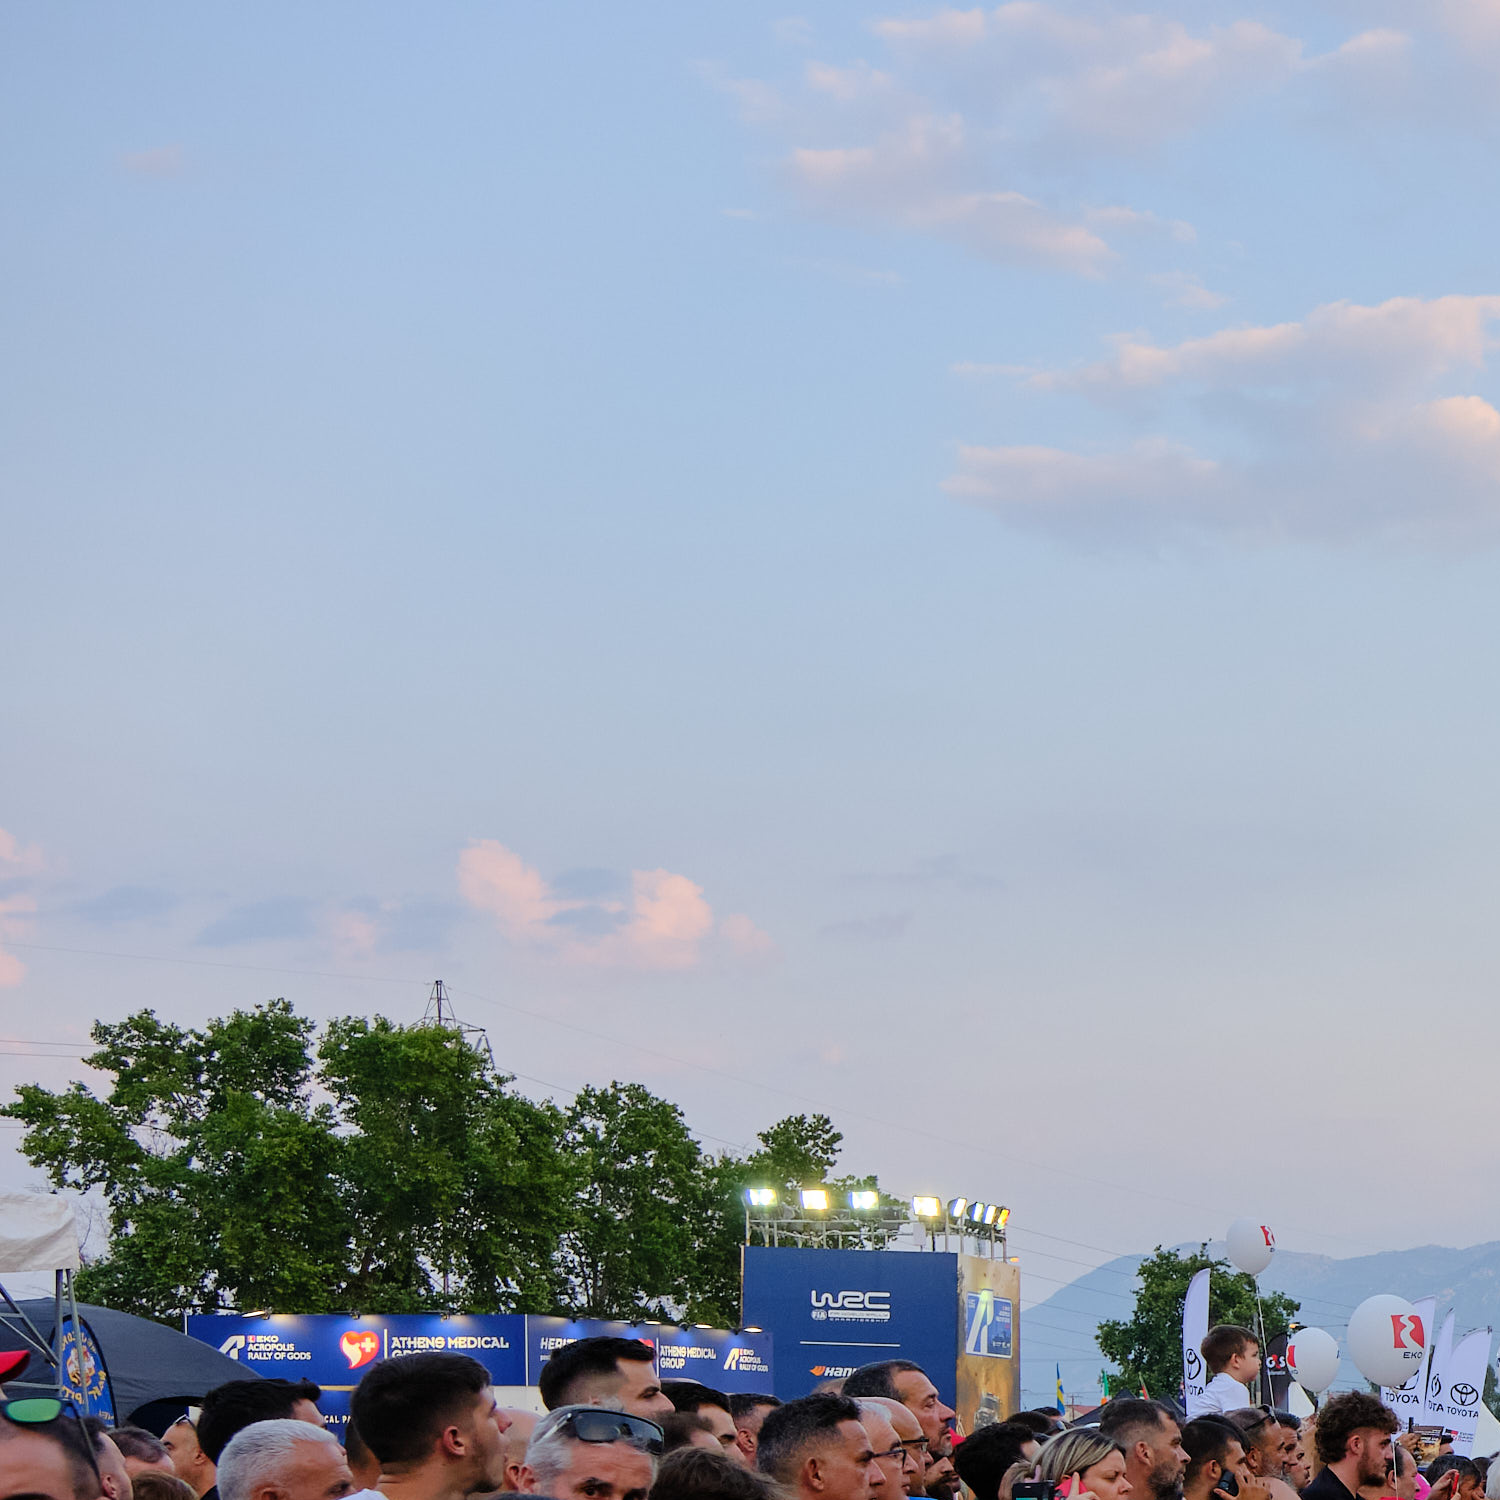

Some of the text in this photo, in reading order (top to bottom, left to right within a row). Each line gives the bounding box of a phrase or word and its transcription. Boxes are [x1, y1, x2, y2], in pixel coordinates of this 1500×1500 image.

[811, 1290, 891, 1308] WRC
[247, 1343, 295, 1352] ACROPOLIS
[391, 1336, 510, 1349] ATHENS MEDICAL
[247, 1352, 312, 1361] RALLY OF GODS
[660, 1345, 717, 1360] ATHENS MEDICAL
[1403, 1351, 1423, 1359] EKO
[660, 1357, 686, 1369] GROUP
[1447, 1406, 1480, 1418] TOYOTA
